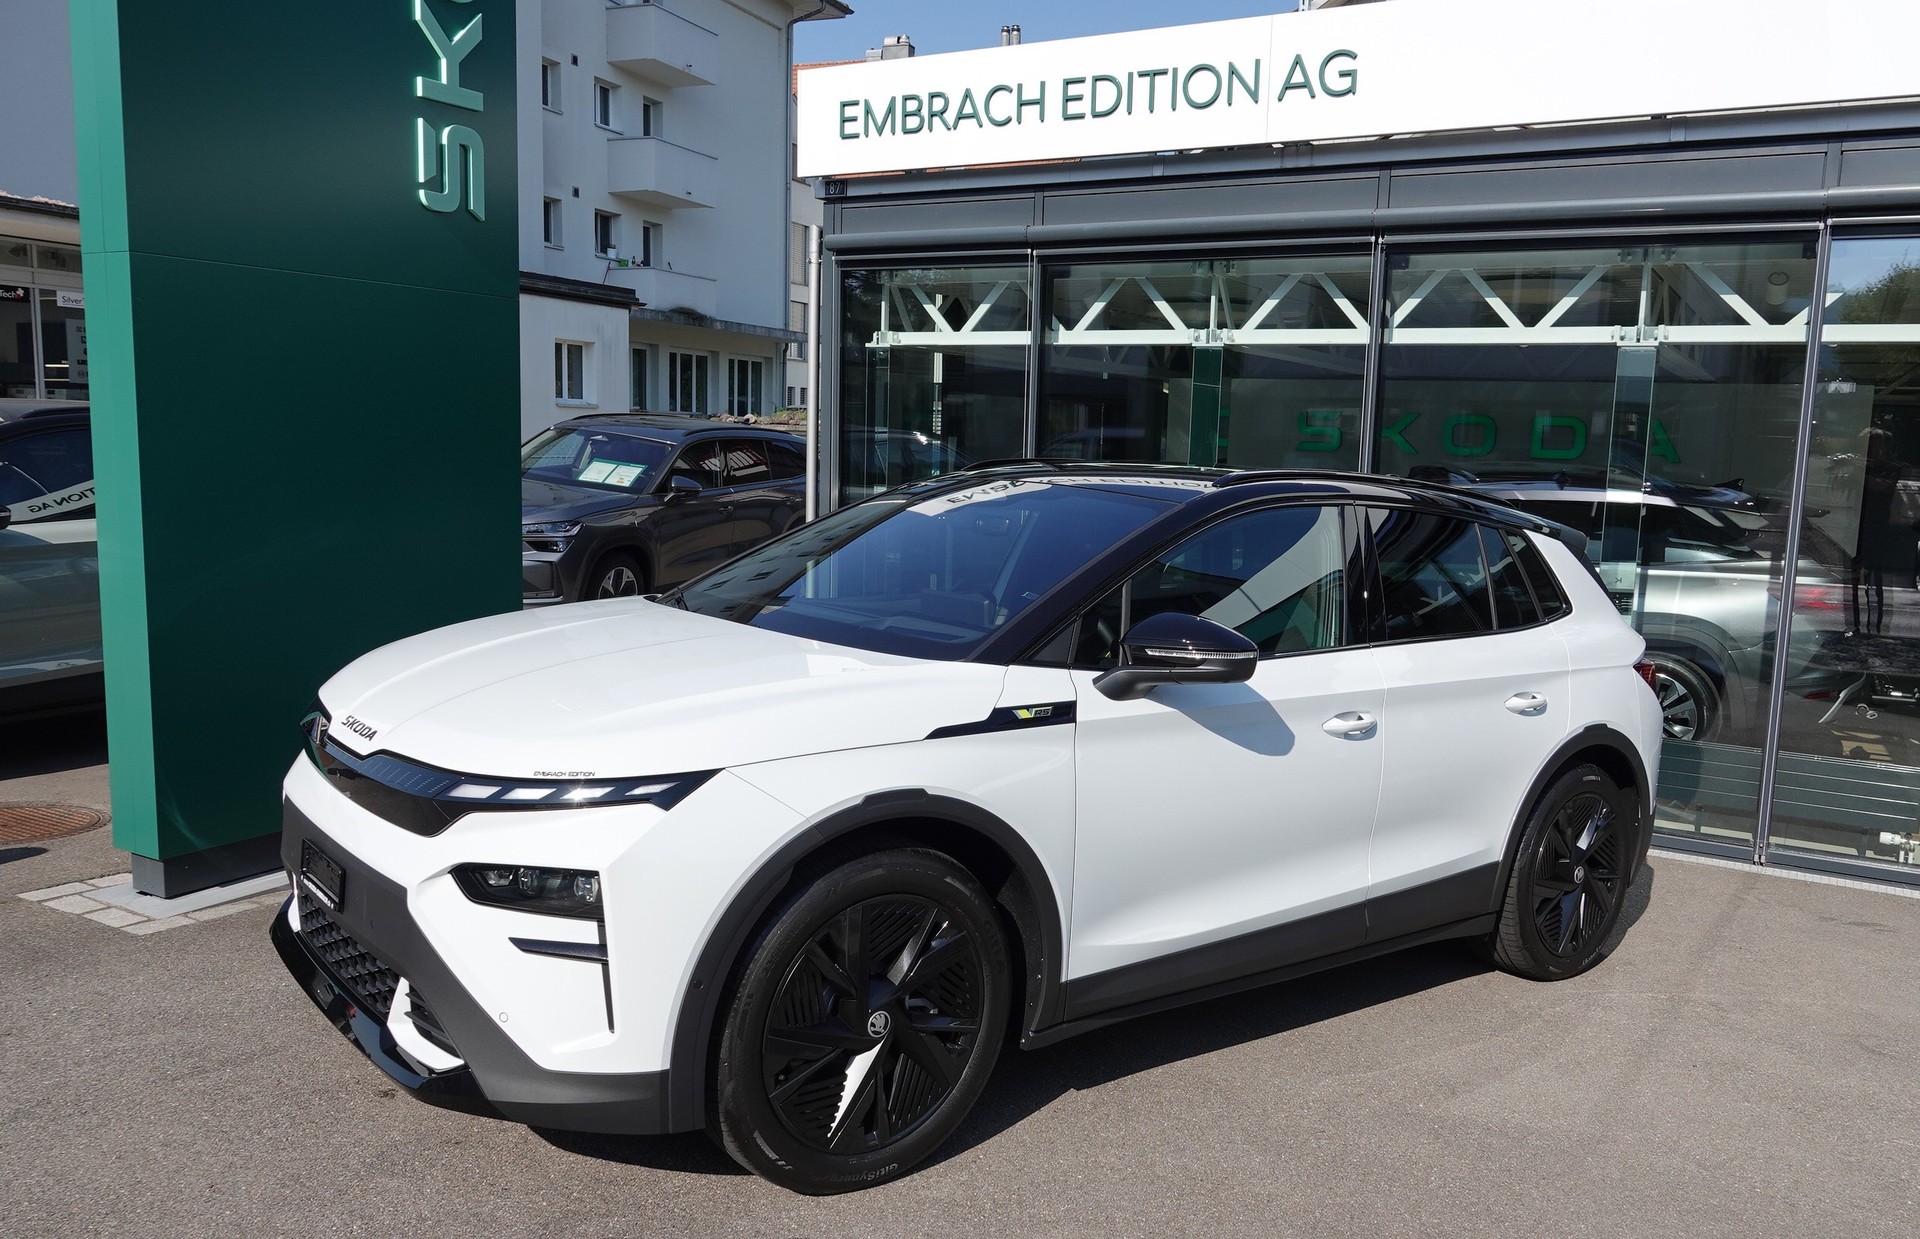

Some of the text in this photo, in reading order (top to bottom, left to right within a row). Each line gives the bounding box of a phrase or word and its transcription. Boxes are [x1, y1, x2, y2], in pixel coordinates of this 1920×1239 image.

[839, 48, 1358, 140] EMBRACH EDITION AG
[829, 182, 841, 194] 87
[61, 295, 84, 305] Silver
